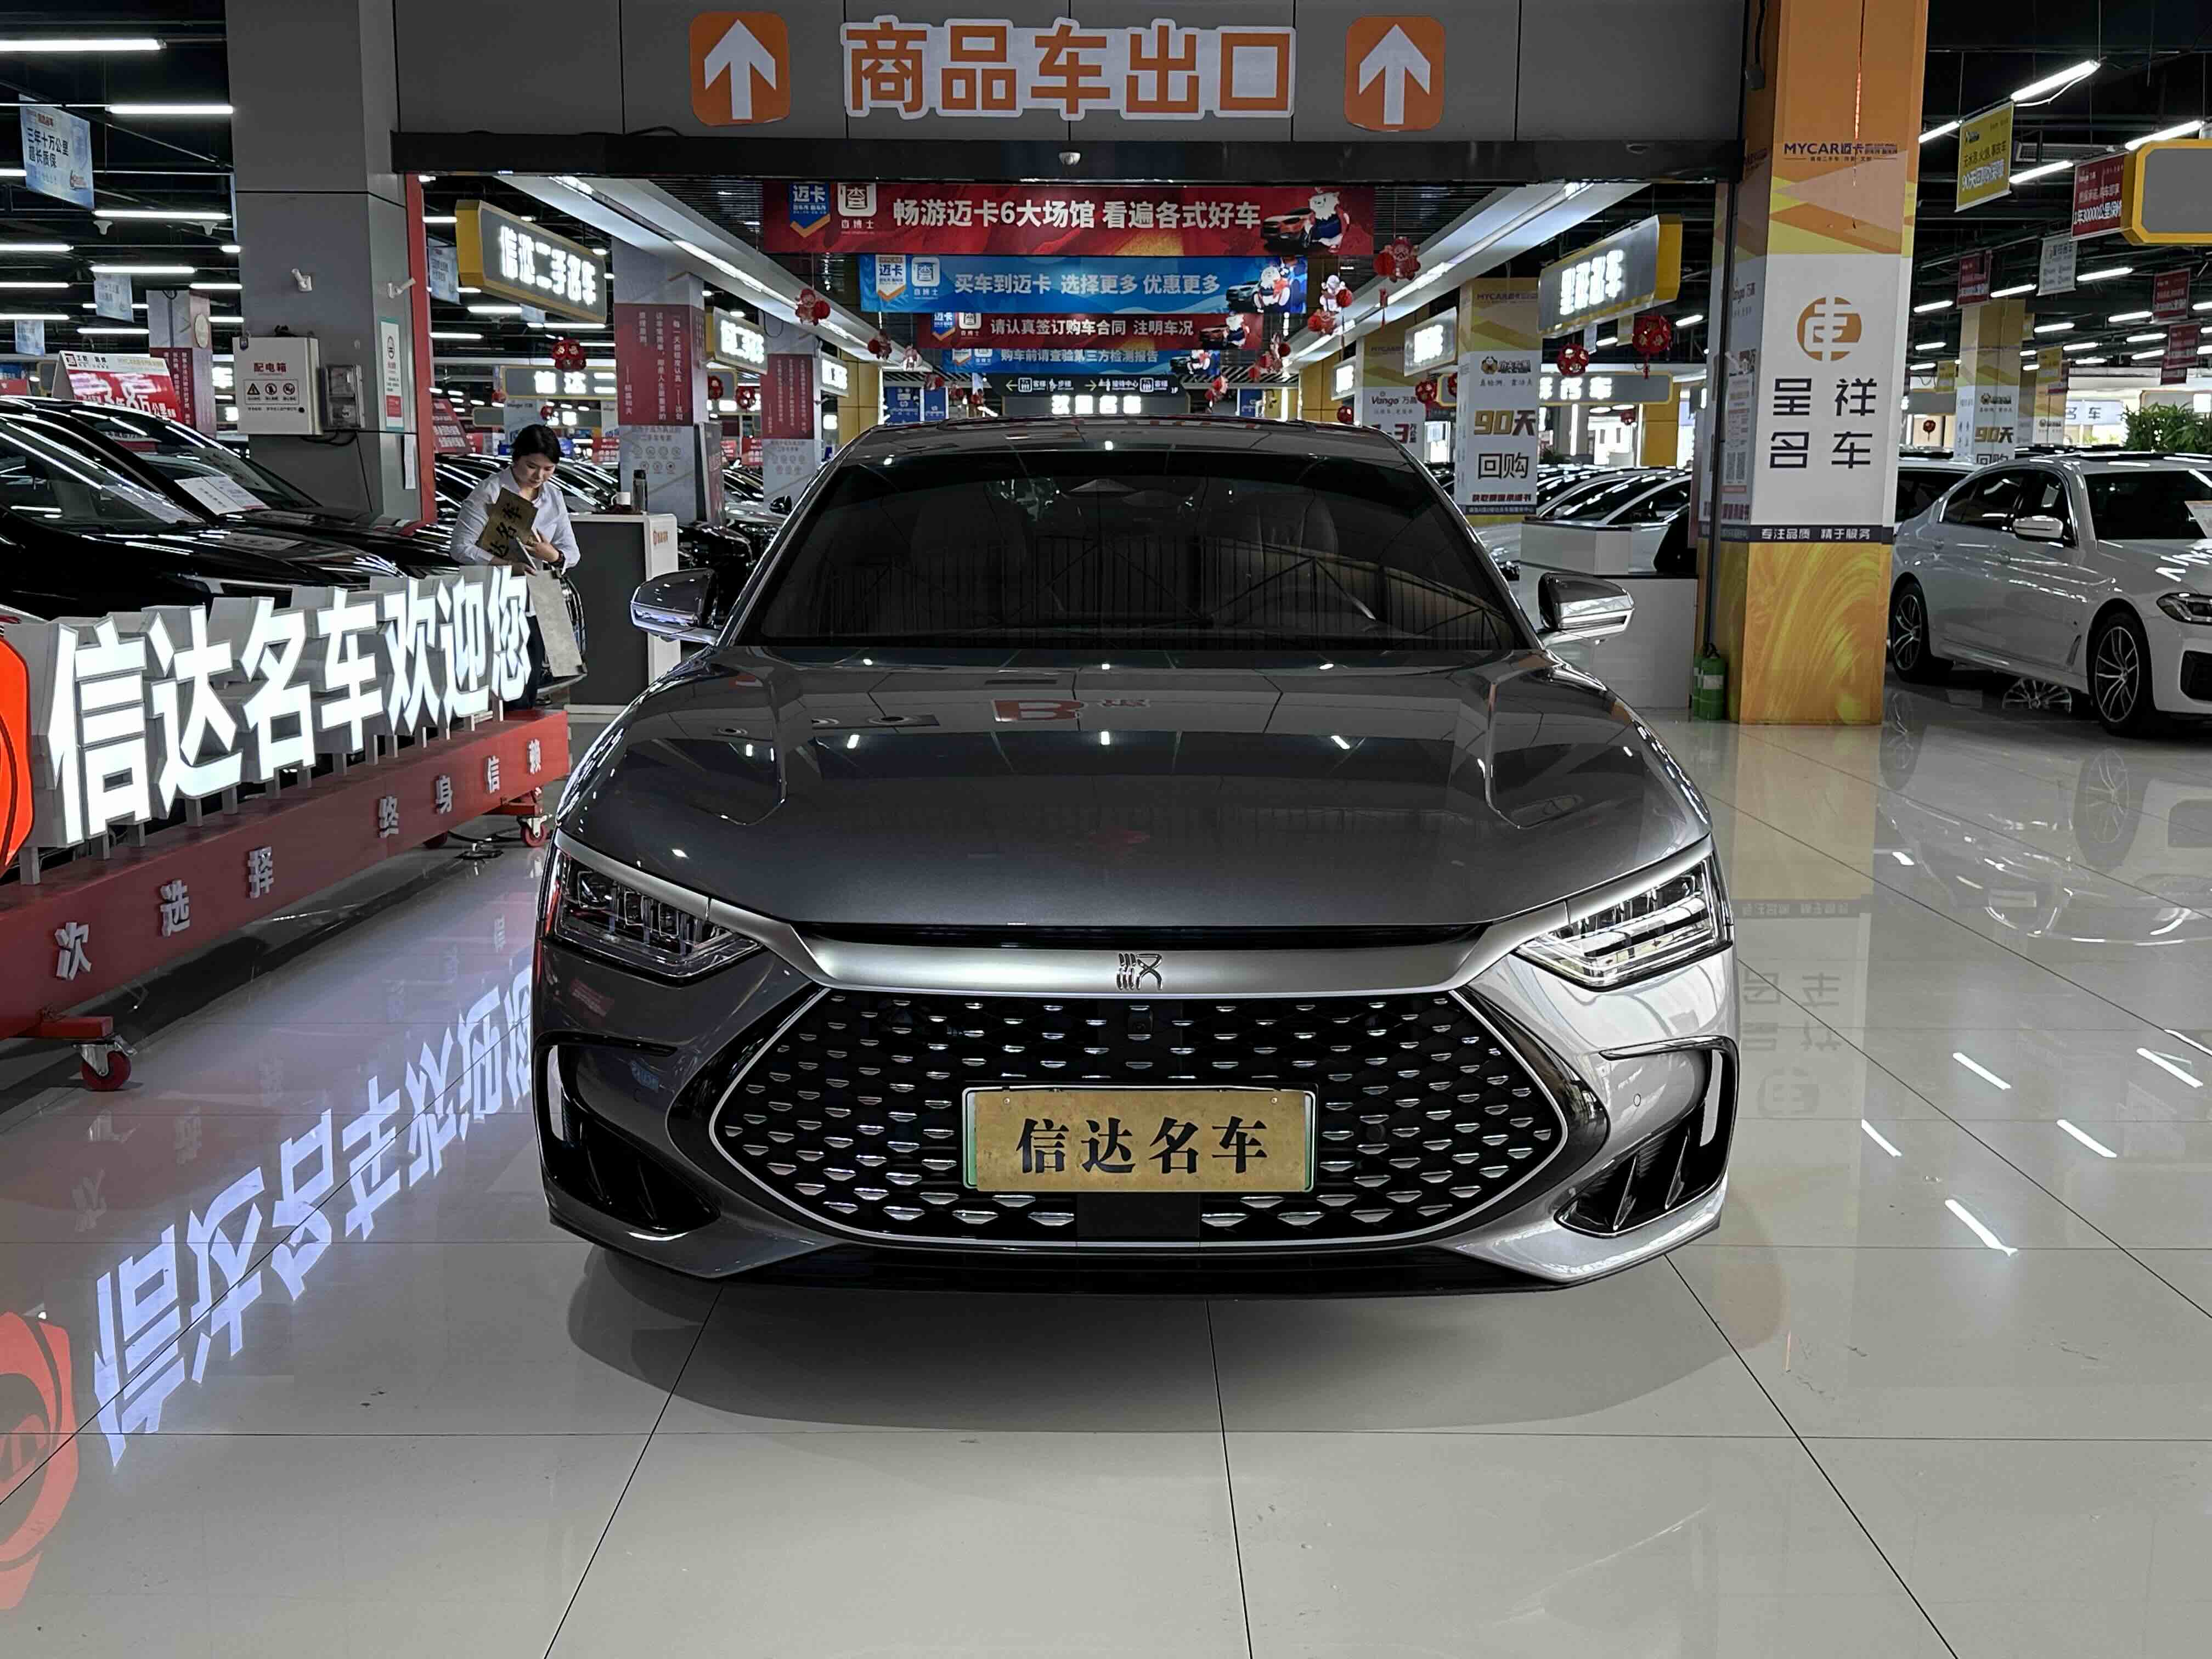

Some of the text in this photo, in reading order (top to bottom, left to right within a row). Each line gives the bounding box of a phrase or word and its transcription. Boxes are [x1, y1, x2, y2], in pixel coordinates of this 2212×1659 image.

[847, 22, 1291, 114] 商品车出口
[793, 185, 826, 202] 迈卡
[893, 198, 1261, 229] 畅游迈卡6大场馆 看遍各式好车
[879, 264, 902, 276] 迈卡
[954, 274, 1221, 294] 买车到迈卡 选择更多 优惠更多
[990, 319, 1194, 336] 请认真签订购车合同 注明车况
[253, 362, 287, 373] 配电箱
[1001, 349, 1159, 363] 购车前请查验第三方检测报告
[1372, 396, 1398, 407] Vango
[1773, 377, 1877, 416] 呈祥
[1474, 410, 1536, 436] 90天
[1975, 427, 2014, 443] 90天
[1770, 431, 1872, 469] 名车
[1478, 452, 1529, 479] 回购
[1761, 528, 1810, 539] 专注品质
[47, 565, 532, 846] 信达名车欢迎您
[377, 739, 542, 838] 终身信赖
[1016, 1116, 1268, 1174] 信达名车
